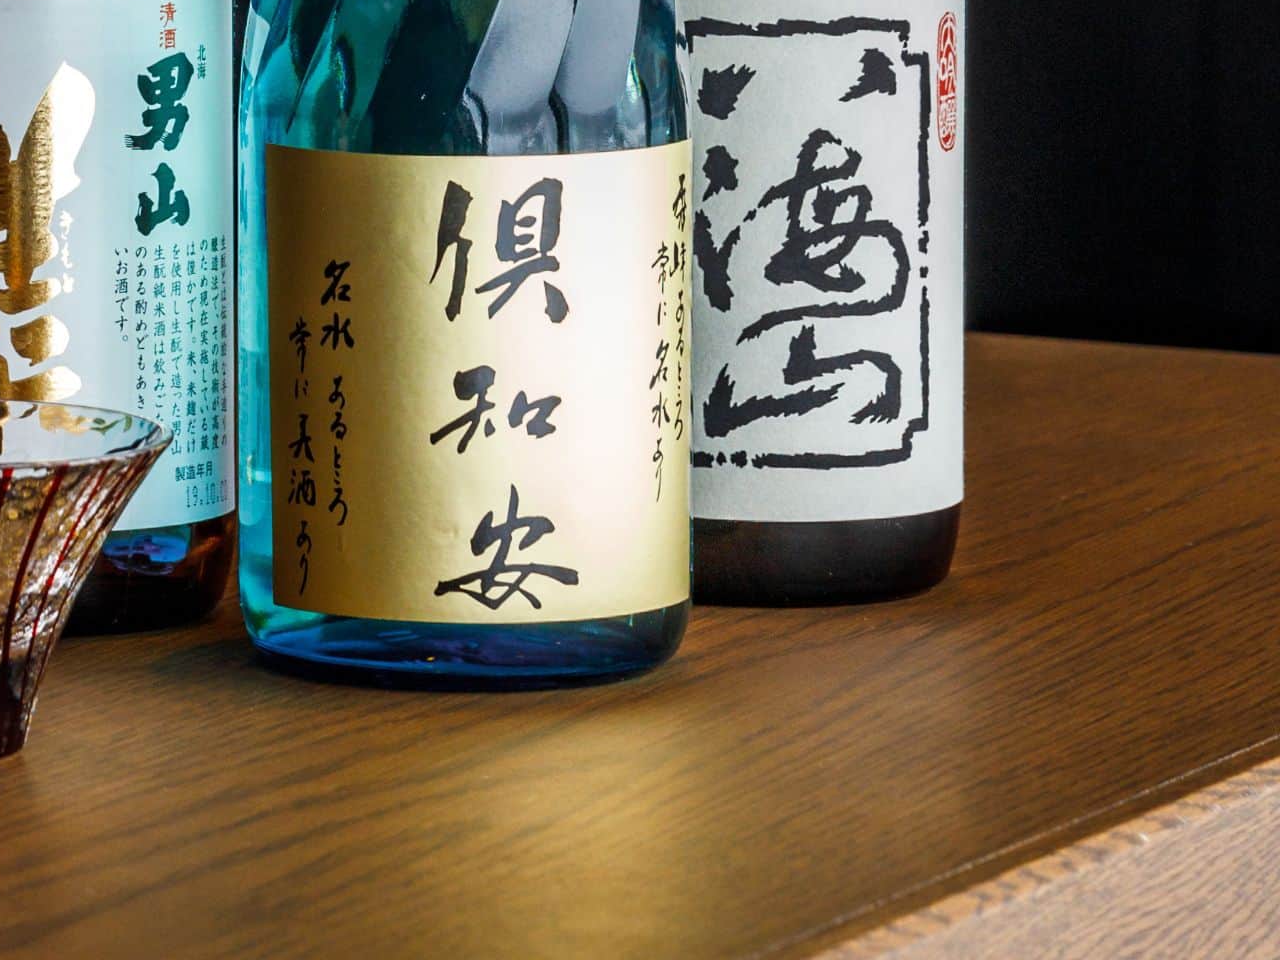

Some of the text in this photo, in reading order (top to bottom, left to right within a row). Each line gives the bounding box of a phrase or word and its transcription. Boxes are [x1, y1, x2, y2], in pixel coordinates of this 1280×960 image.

[159, 2, 176, 49] 清酒
[124, 52, 194, 237] 男山
[175, 461, 213, 481] 製造年月
[288, 316, 317, 596] 常に美酒あり
[320, 259, 355, 527] 名水あるところ
